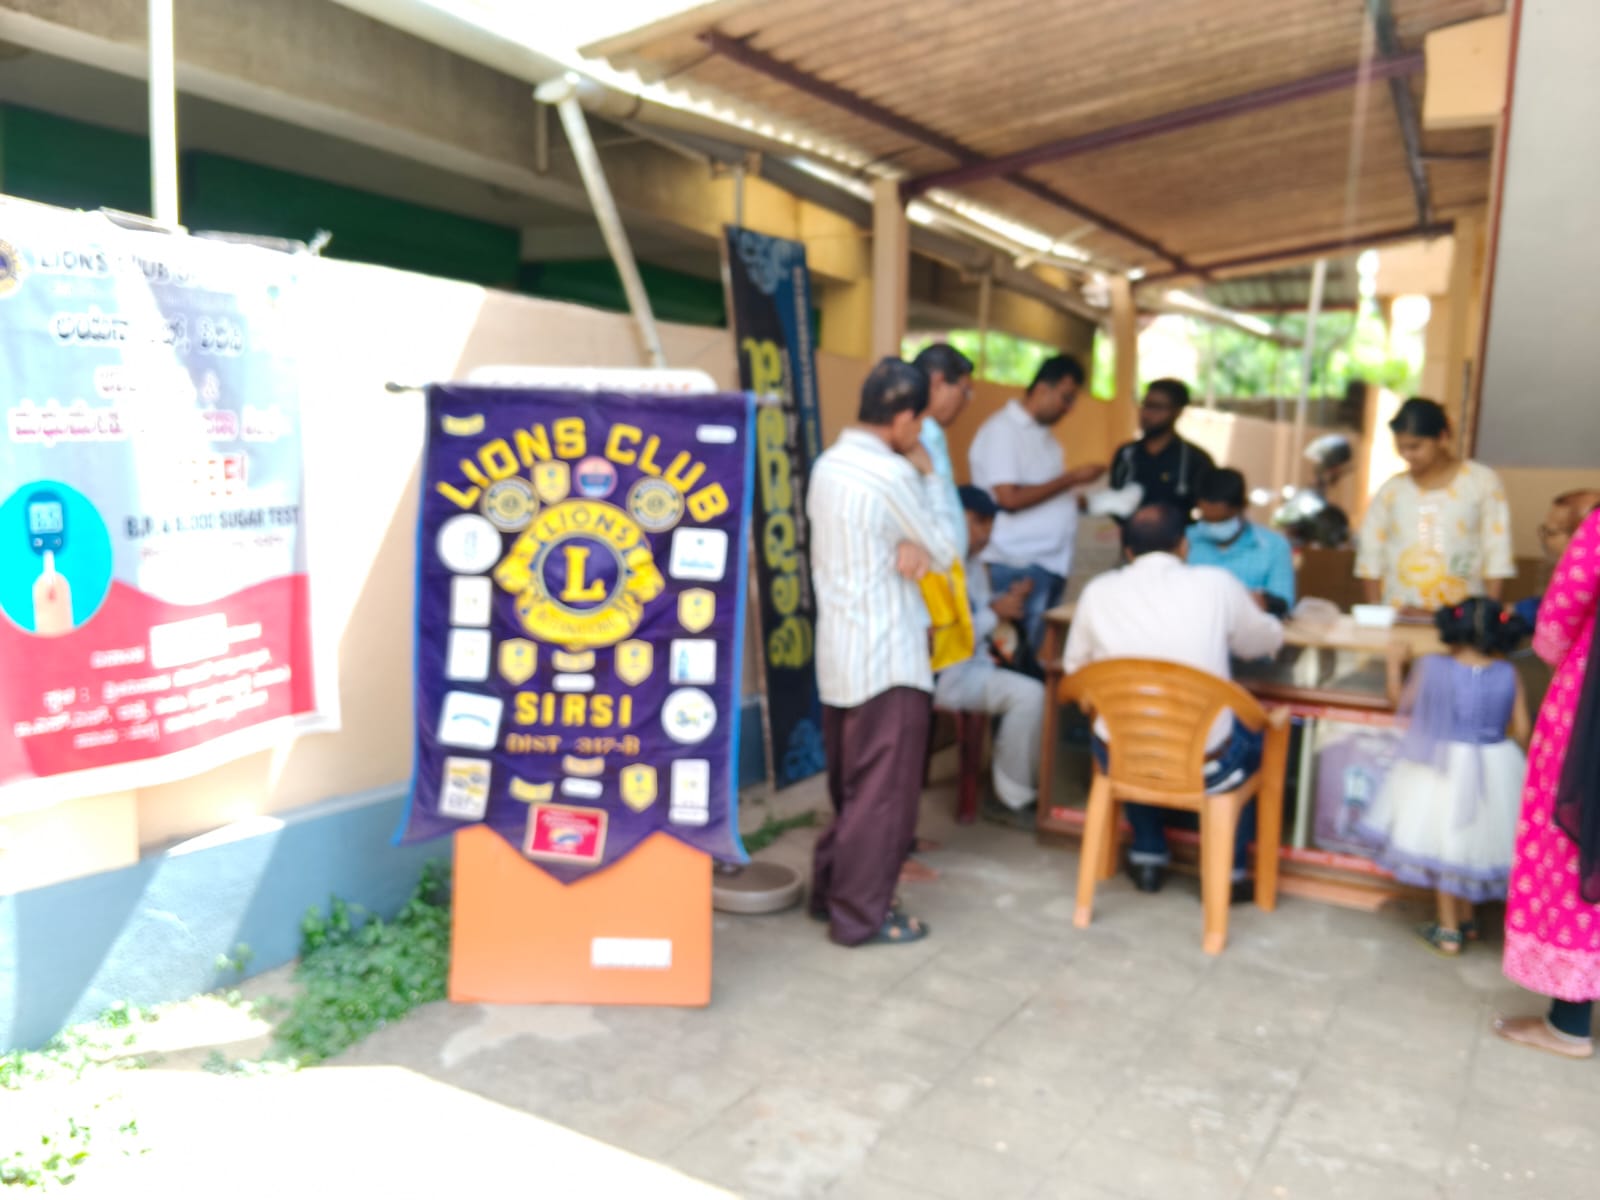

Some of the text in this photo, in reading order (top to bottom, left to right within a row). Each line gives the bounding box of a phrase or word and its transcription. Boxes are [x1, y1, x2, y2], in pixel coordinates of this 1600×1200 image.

[40, 249, 108, 274] LIONS
[434, 416, 730, 523] LIONS CLUB
[218, 508, 265, 530] SUGAR
[267, 503, 300, 527] TEST
[544, 505, 631, 542] LIONS
[560, 545, 607, 602] L
[514, 691, 633, 729] SIRSI
